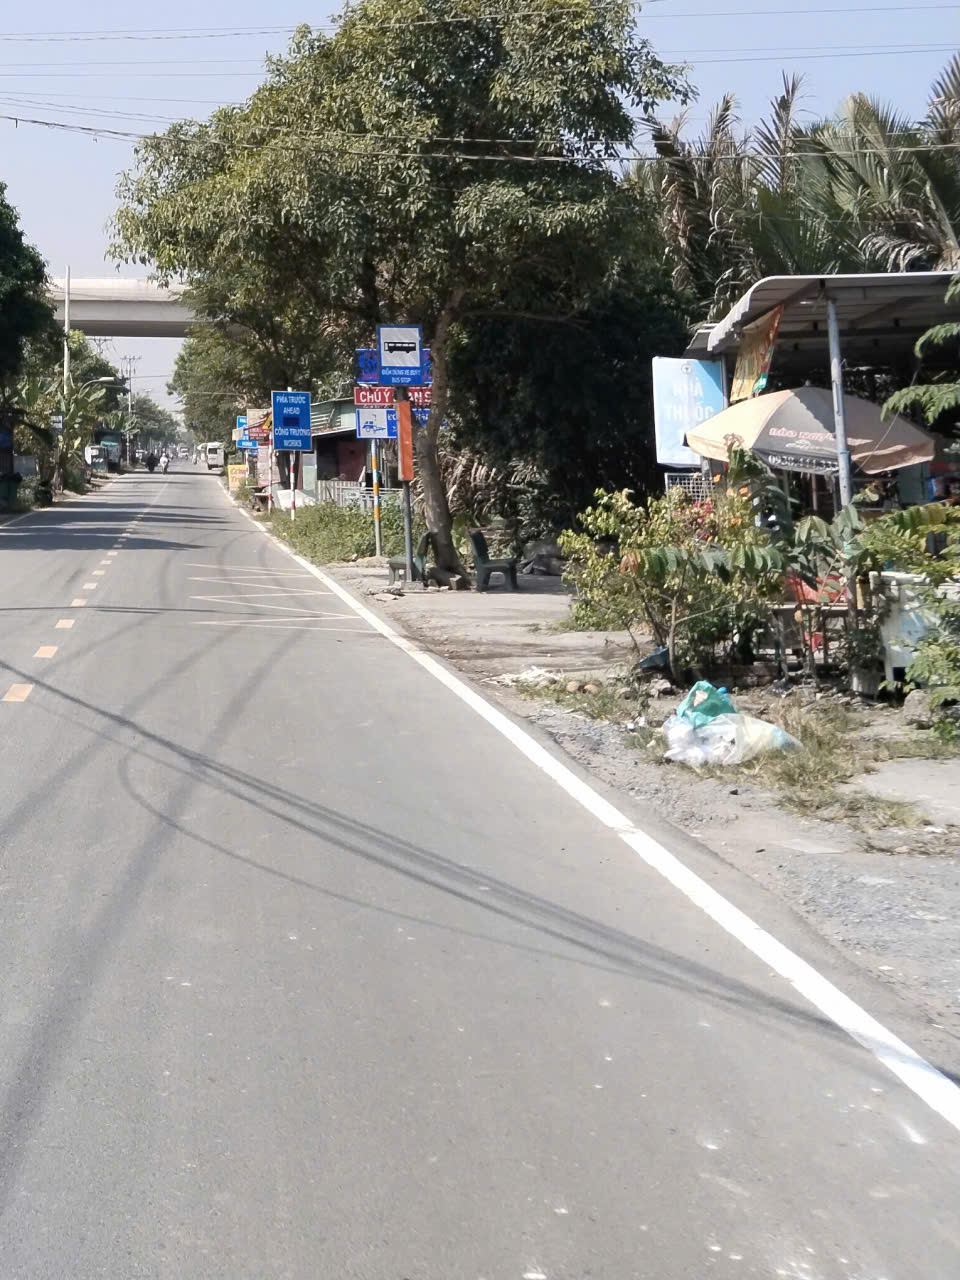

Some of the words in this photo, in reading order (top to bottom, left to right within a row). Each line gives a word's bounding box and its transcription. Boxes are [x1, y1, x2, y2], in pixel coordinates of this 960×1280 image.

[360, 388, 381, 403] CHÚ
[383, 388, 391, 403] Ý
[283, 407, 300, 415] AHEAD
